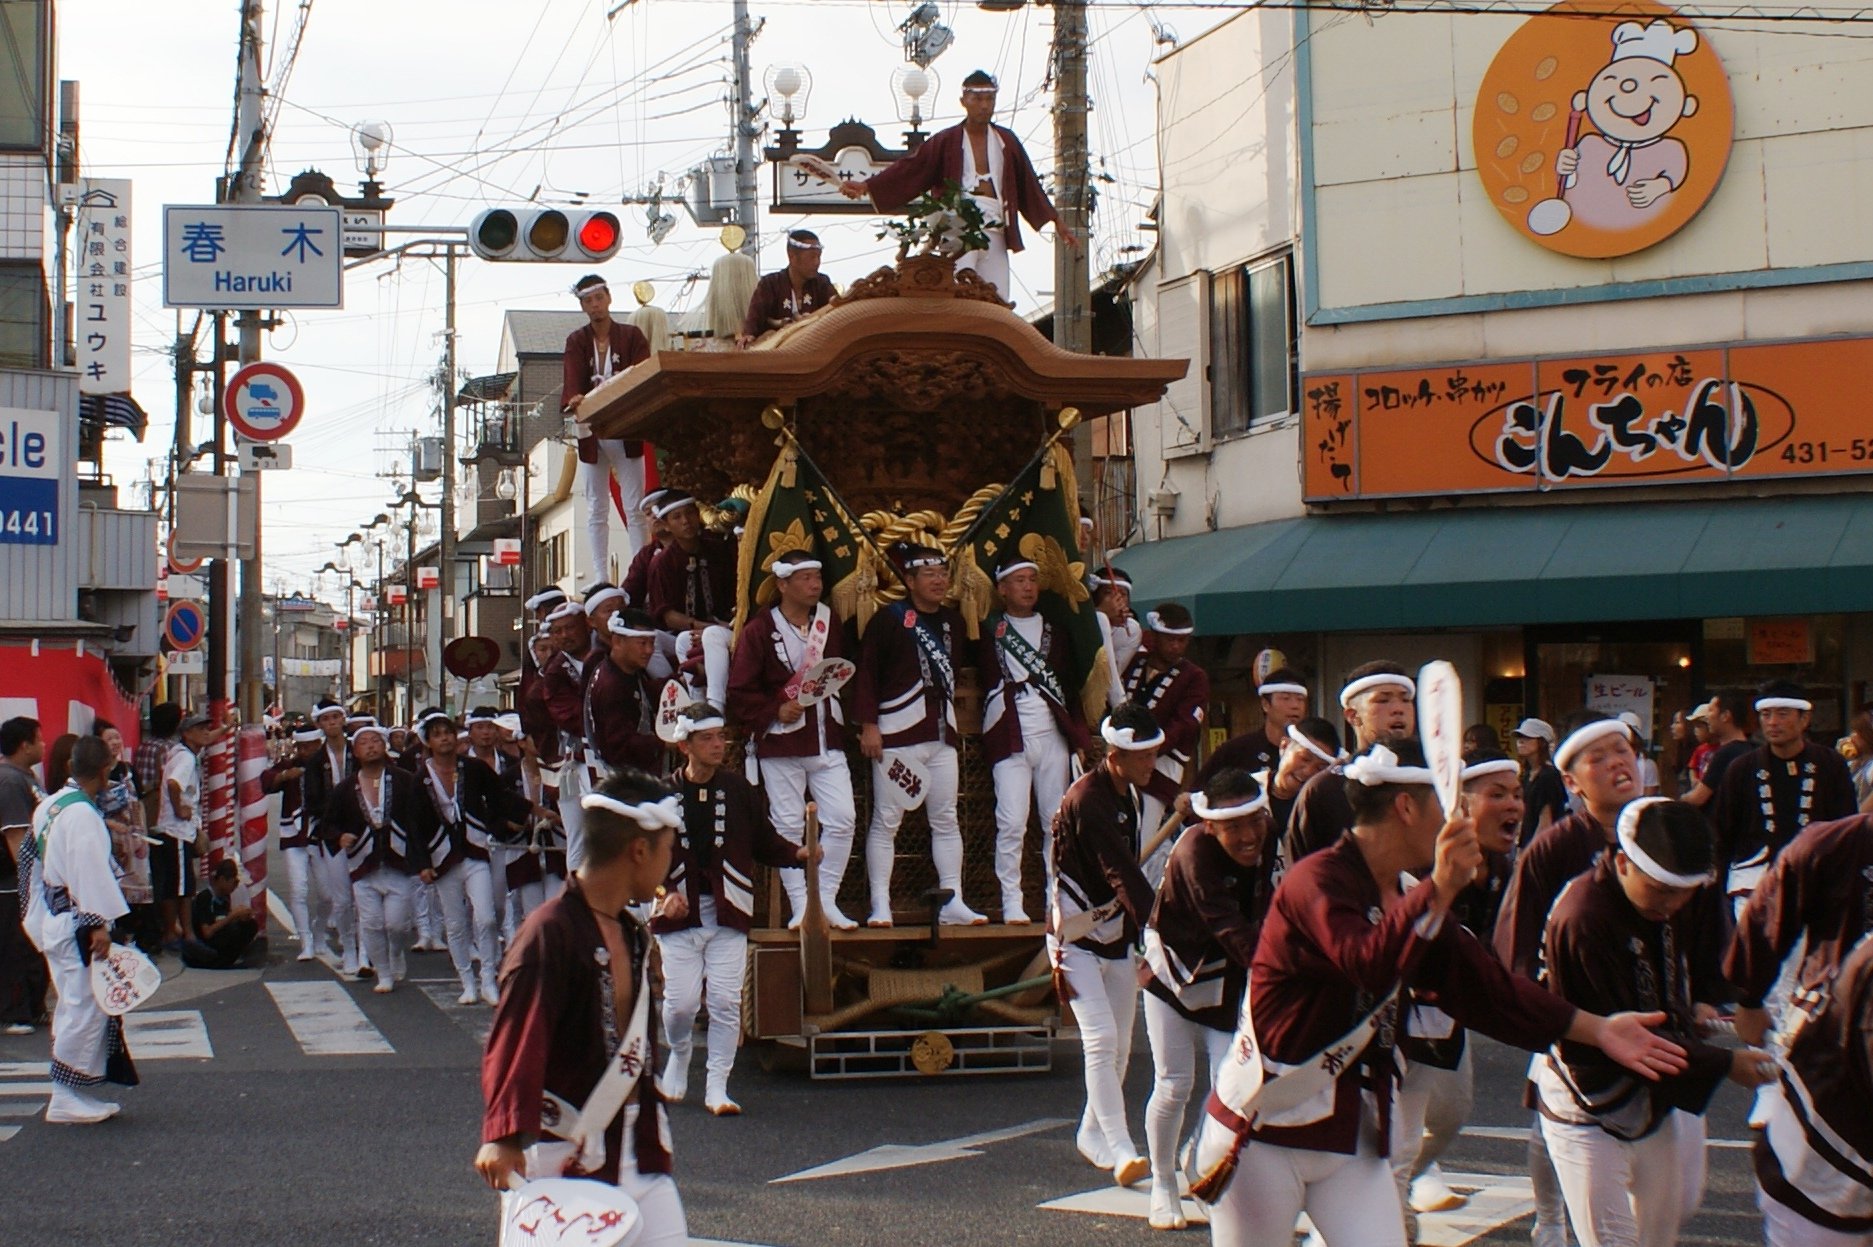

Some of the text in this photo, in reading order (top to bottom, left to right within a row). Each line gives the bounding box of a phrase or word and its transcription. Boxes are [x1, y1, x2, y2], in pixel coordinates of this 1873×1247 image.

[182, 222, 324, 264] 春木
[214, 270, 292, 293] Haruki
[1562, 355, 1694, 398] フライの店
[0, 421, 45, 468] le
[1308, 381, 1351, 492] 揚げたて
[0, 509, 52, 536] 441
[1594, 683, 1648, 698] 生ビール
